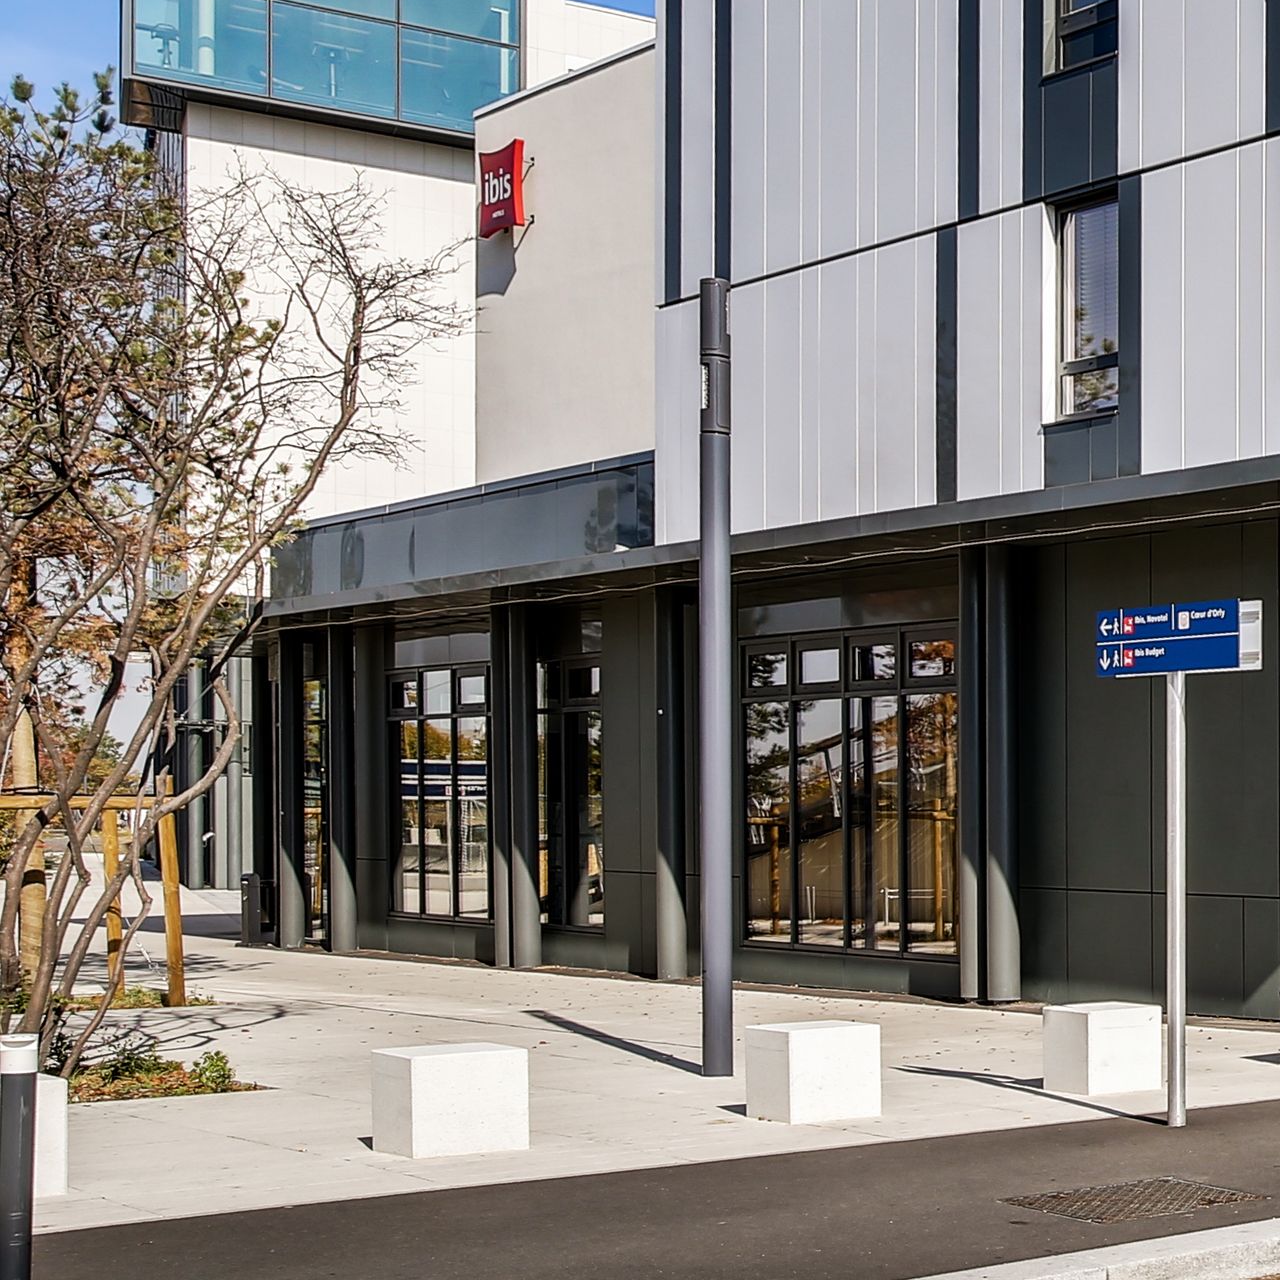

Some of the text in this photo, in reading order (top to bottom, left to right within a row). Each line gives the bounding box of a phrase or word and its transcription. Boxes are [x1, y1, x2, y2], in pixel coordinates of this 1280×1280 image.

[484, 167, 511, 206] ibis
[1146, 612, 1168, 623] Novotel
[1134, 647, 1165, 658] Ibis Budget
